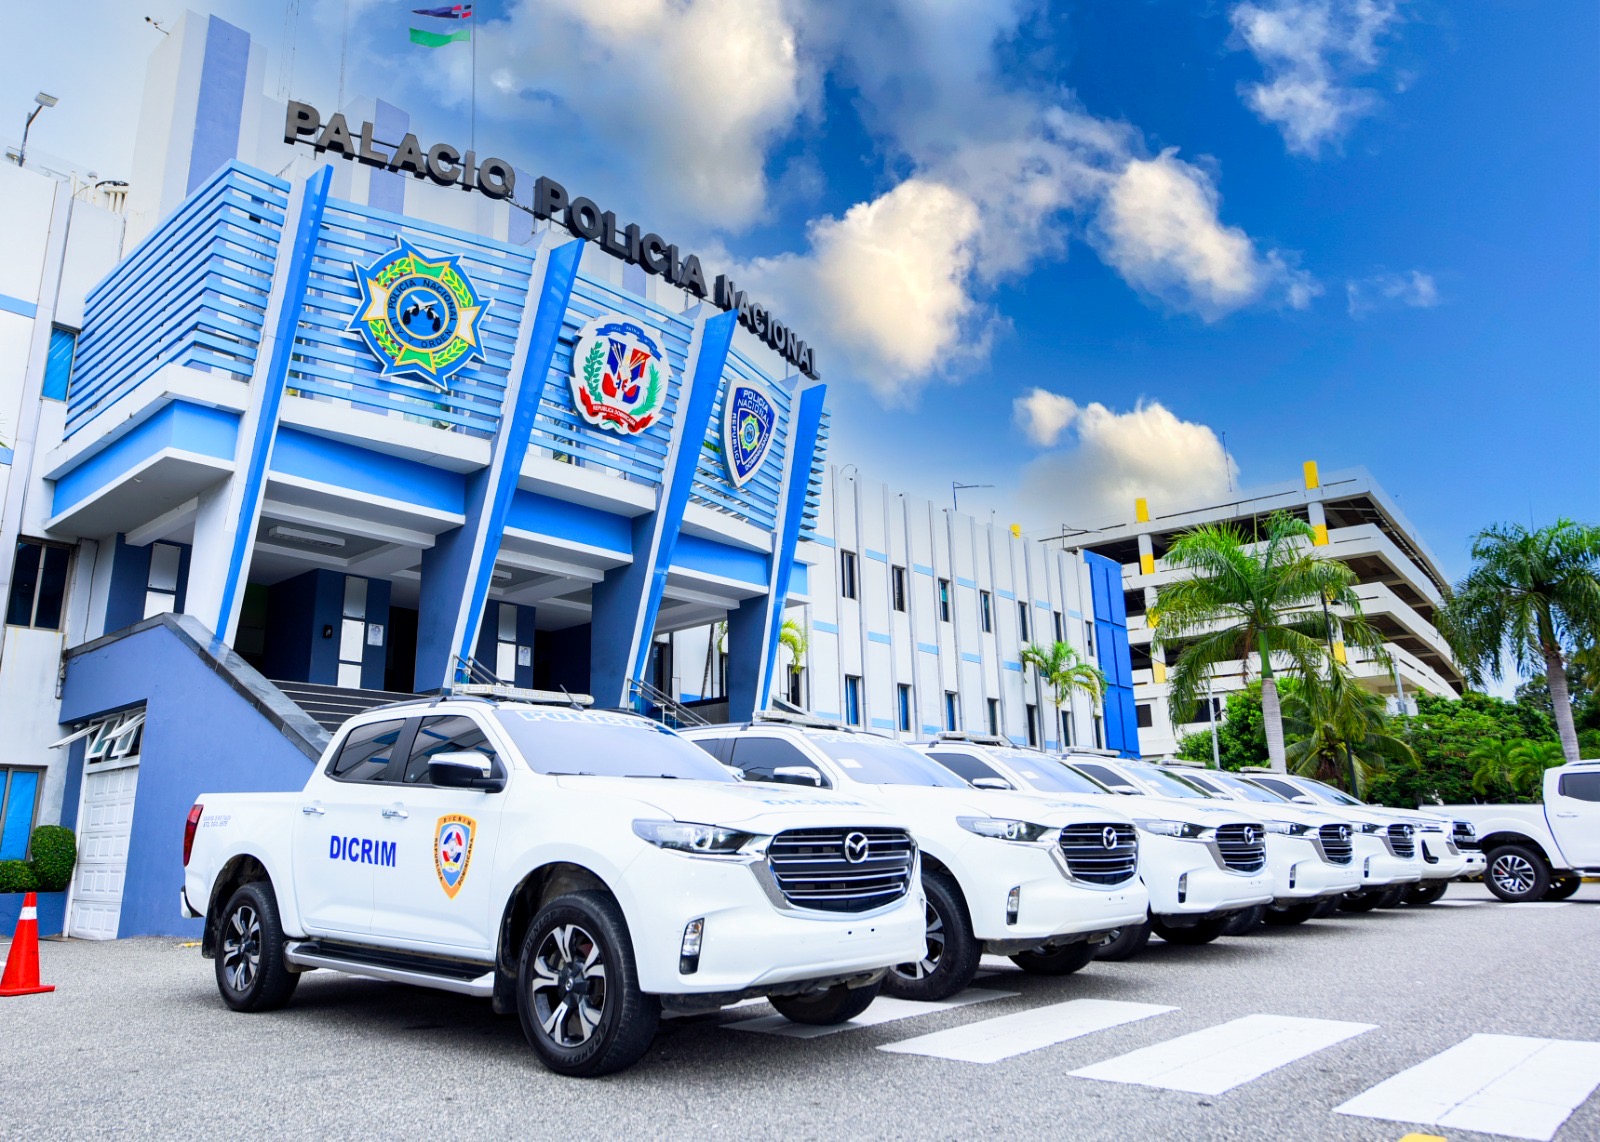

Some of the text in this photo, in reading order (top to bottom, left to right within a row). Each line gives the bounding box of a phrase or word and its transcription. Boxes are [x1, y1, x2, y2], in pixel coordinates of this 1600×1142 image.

[284, 100, 821, 381] PALACIO POLICIA NACIONAL
[388, 279, 458, 321] POLICIA NACIONAL
[389, 316, 453, 349] LEY Y ORDEN
[737, 398, 770, 428] NACIONAL
[743, 389, 769, 413] POLICIA
[732, 412, 770, 471] REPUBLICA DOMINICANA
[329, 835, 397, 868] DICRIM
[434, 837, 474, 886] REPUBLICA DOMINICANA
